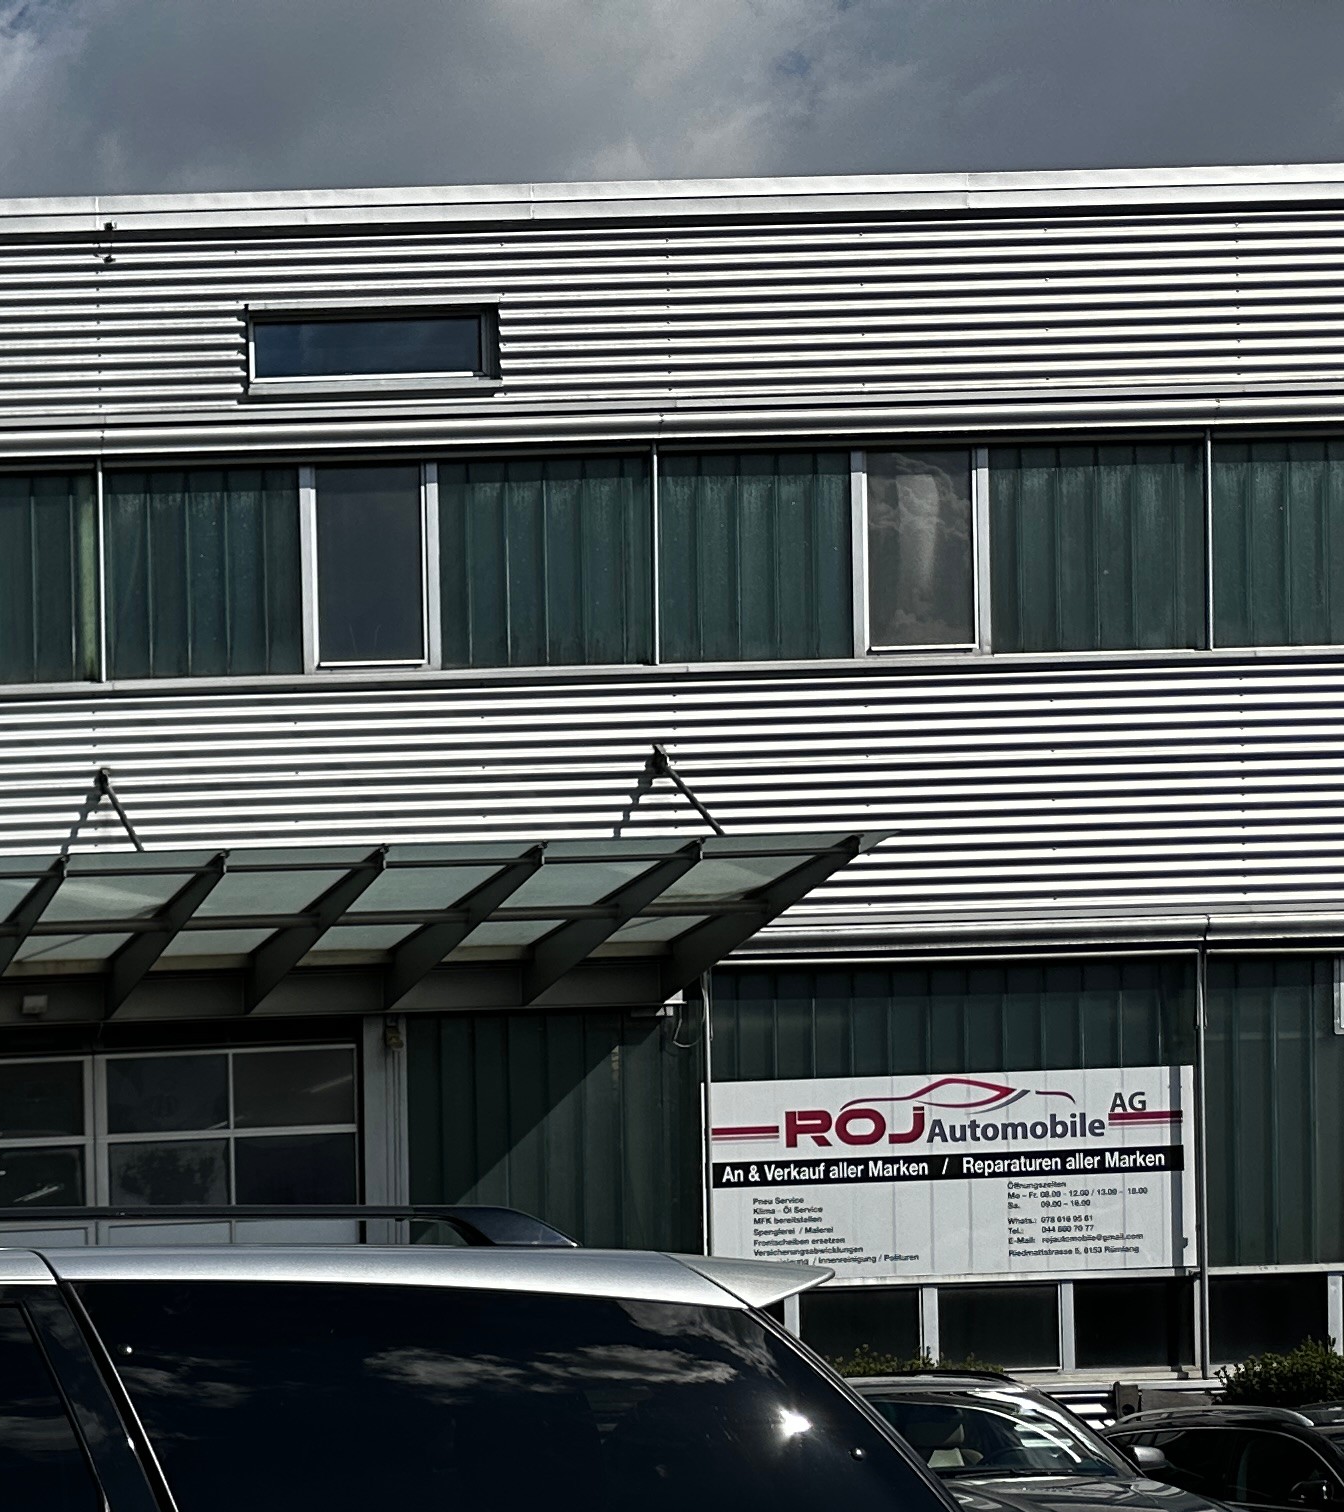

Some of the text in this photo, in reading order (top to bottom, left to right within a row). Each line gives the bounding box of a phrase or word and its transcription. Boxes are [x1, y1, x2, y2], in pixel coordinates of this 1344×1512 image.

[785, 1091, 1147, 1149] ROJ Automobile AG
[722, 1166, 744, 1182] An
[748, 1165, 760, 1181] &
[764, 1162, 825, 1181] Verkauf
[829, 1161, 863, 1179] aller
[868, 1160, 928, 1178] Marken
[962, 1155, 1061, 1176] Reparaturen
[1066, 1153, 1100, 1170] aller
[1105, 1151, 1165, 1168] Marken
[1069, 1189, 1090, 1197] 12.00
[805, 1226, 834, 1234] Malerei
[811, 1237, 845, 1245] ersetzen
